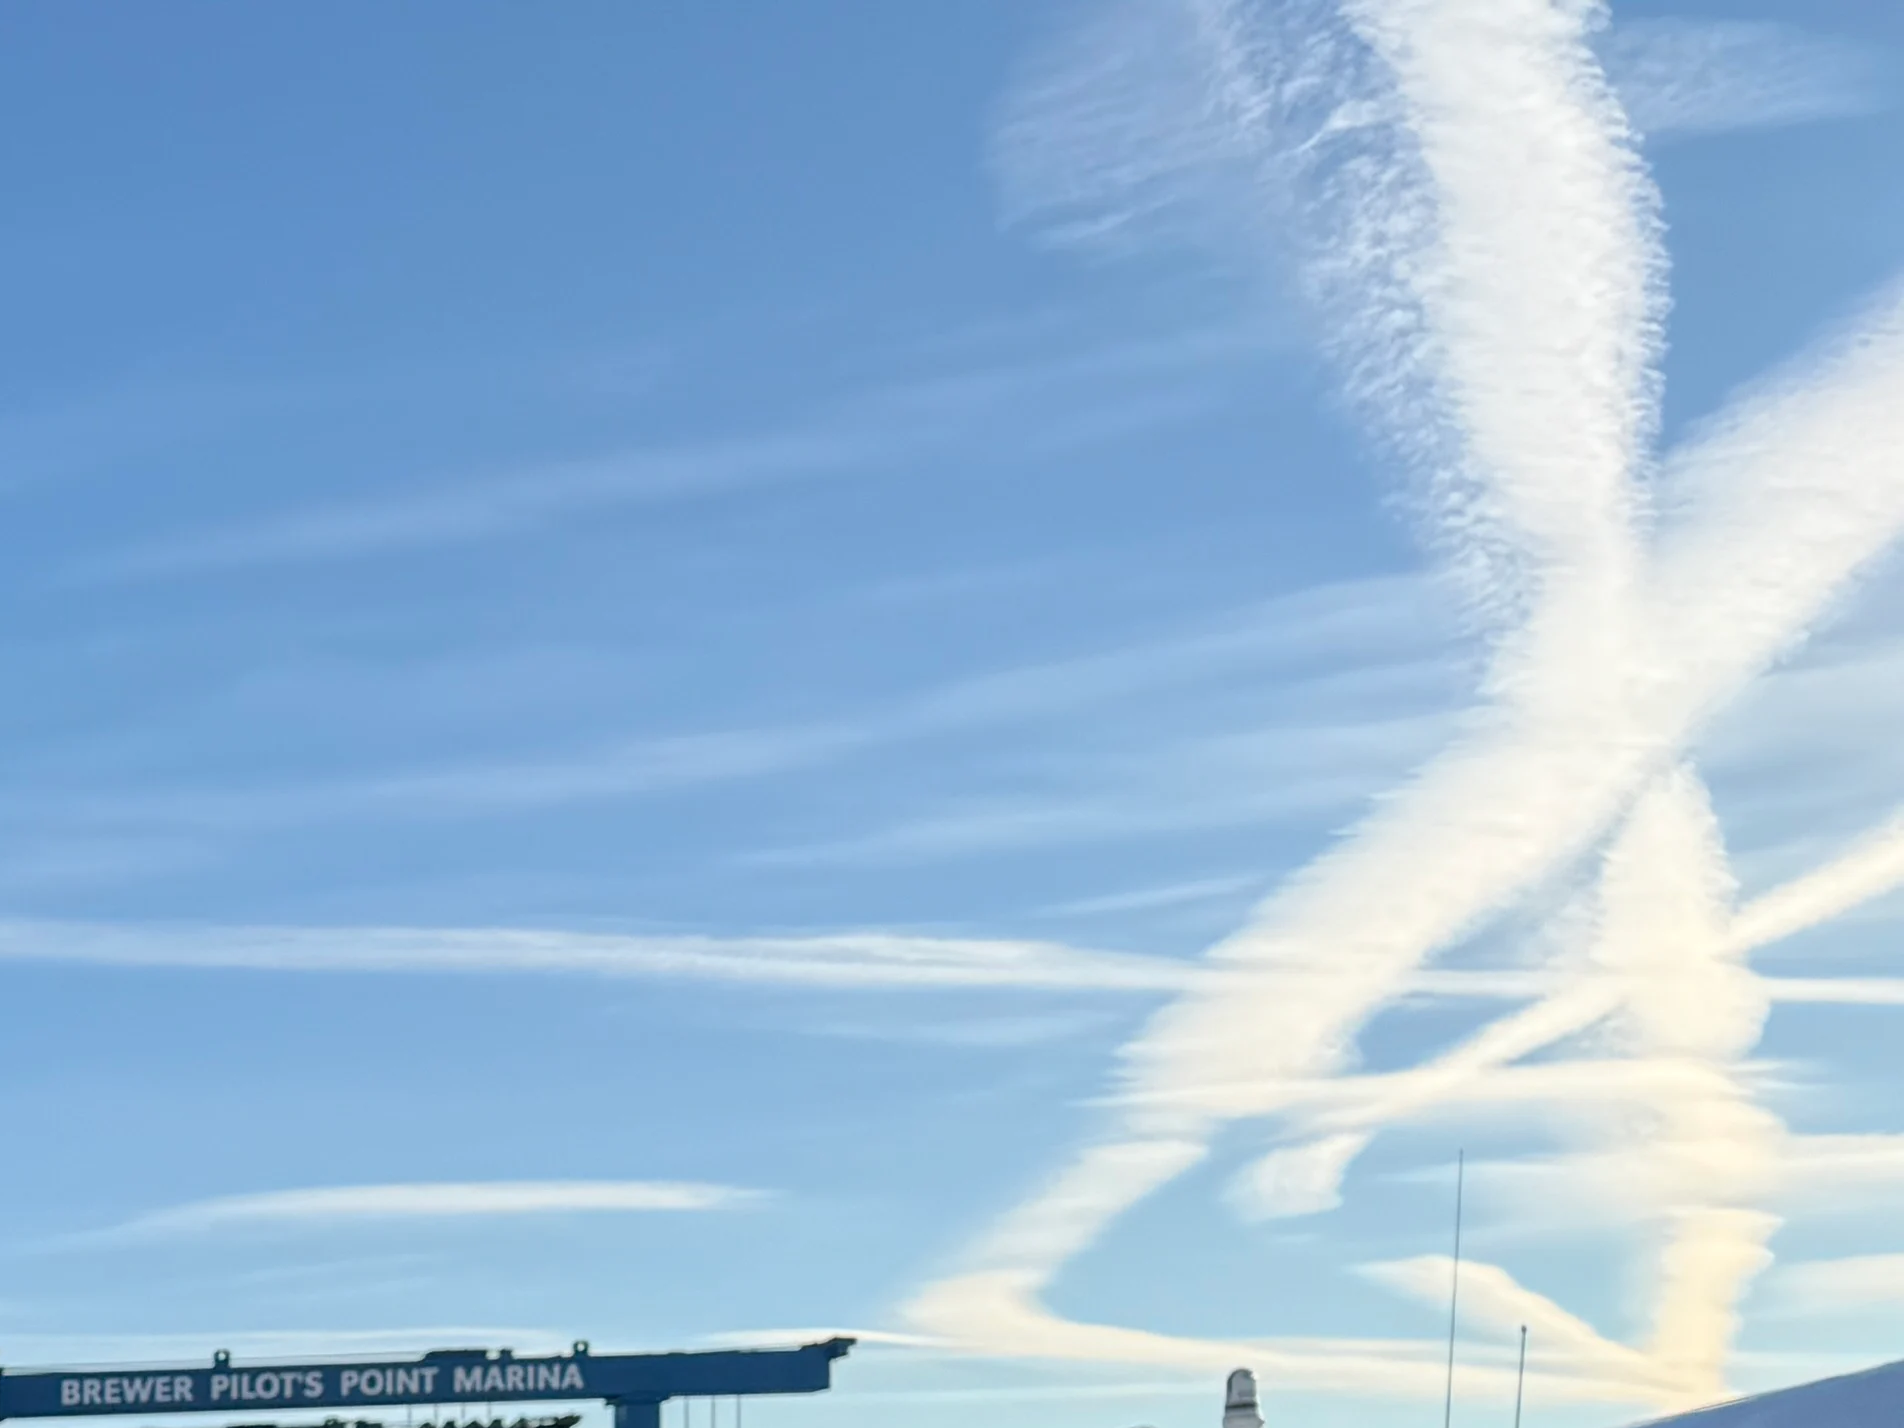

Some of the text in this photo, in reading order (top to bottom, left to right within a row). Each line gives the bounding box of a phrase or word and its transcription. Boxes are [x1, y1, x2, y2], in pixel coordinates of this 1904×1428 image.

[60, 1363, 585, 1406] BREWER PILOT'S POINT MARINA
